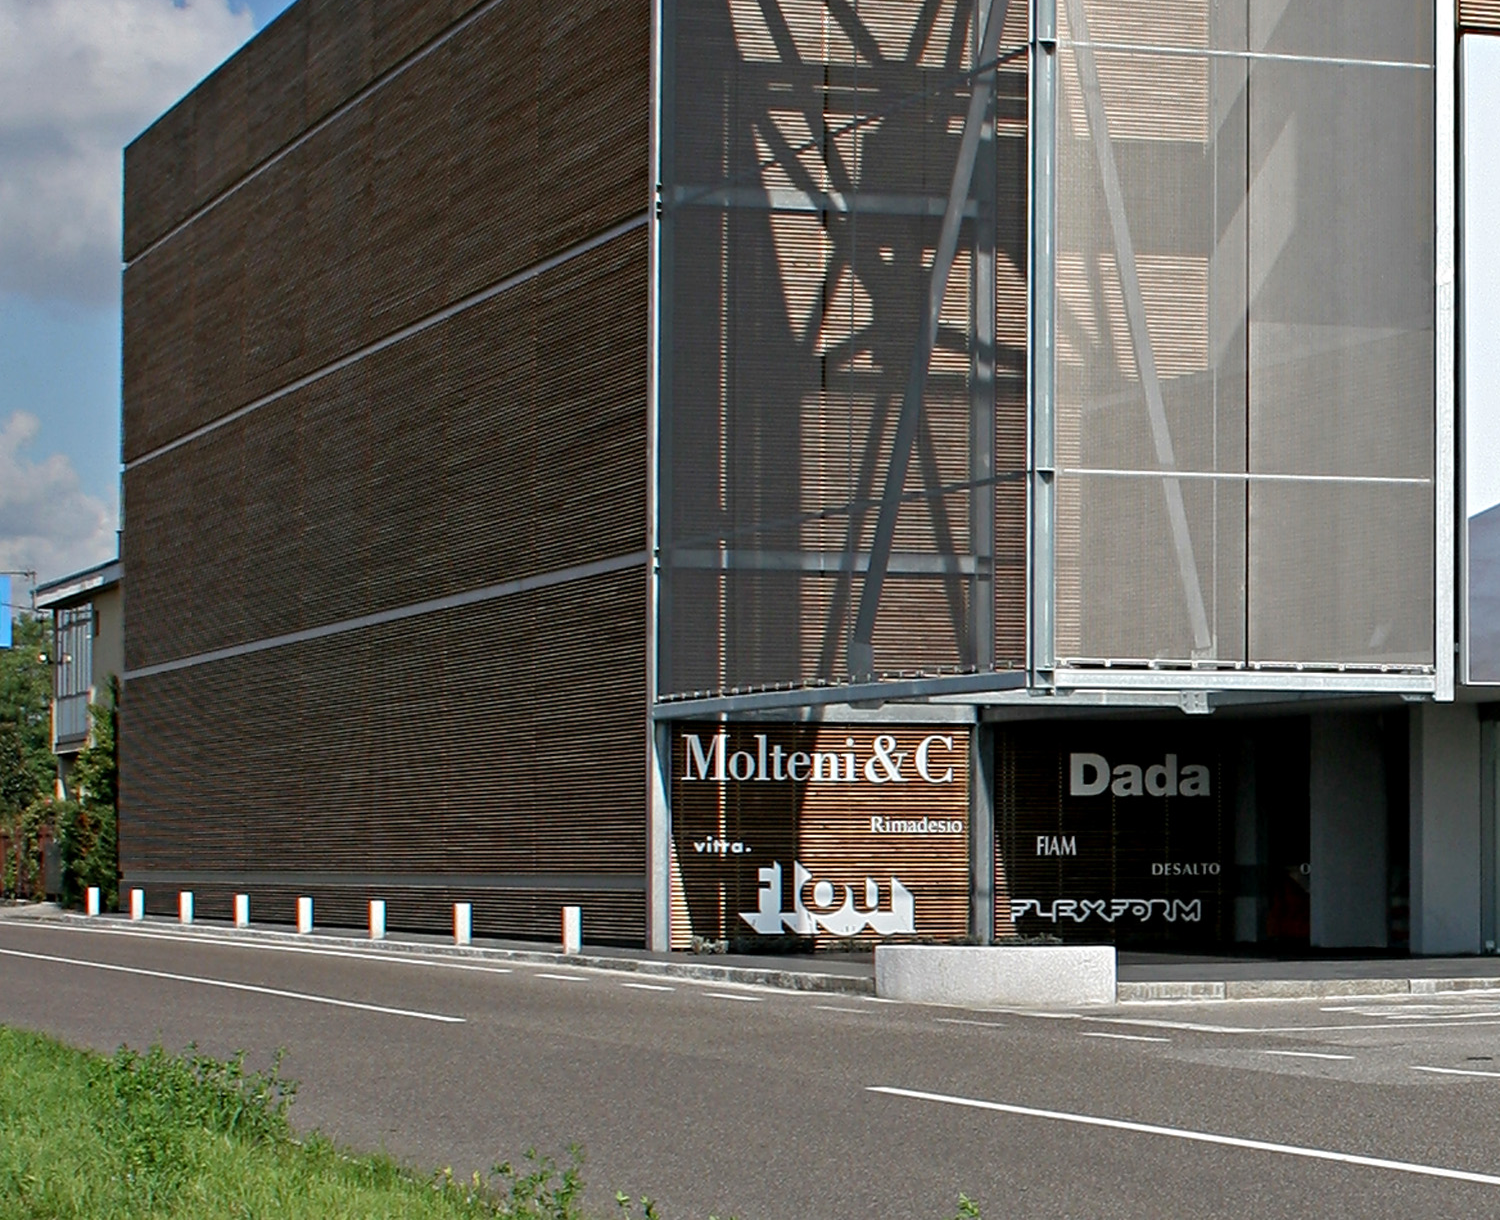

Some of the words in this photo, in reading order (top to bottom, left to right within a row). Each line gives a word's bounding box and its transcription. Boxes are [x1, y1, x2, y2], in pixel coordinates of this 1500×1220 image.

[681, 734, 954, 784] Molteni&C
[1070, 753, 1211, 797] Dada
[869, 816, 963, 835] Rimadesio
[694, 836, 752, 853] vitra.
[1036, 835, 1077, 857] FIAM
[1151, 862, 1222, 876] DESALTO
[738, 860, 917, 936] flou
[1010, 899, 1202, 923] FLEXFORM
